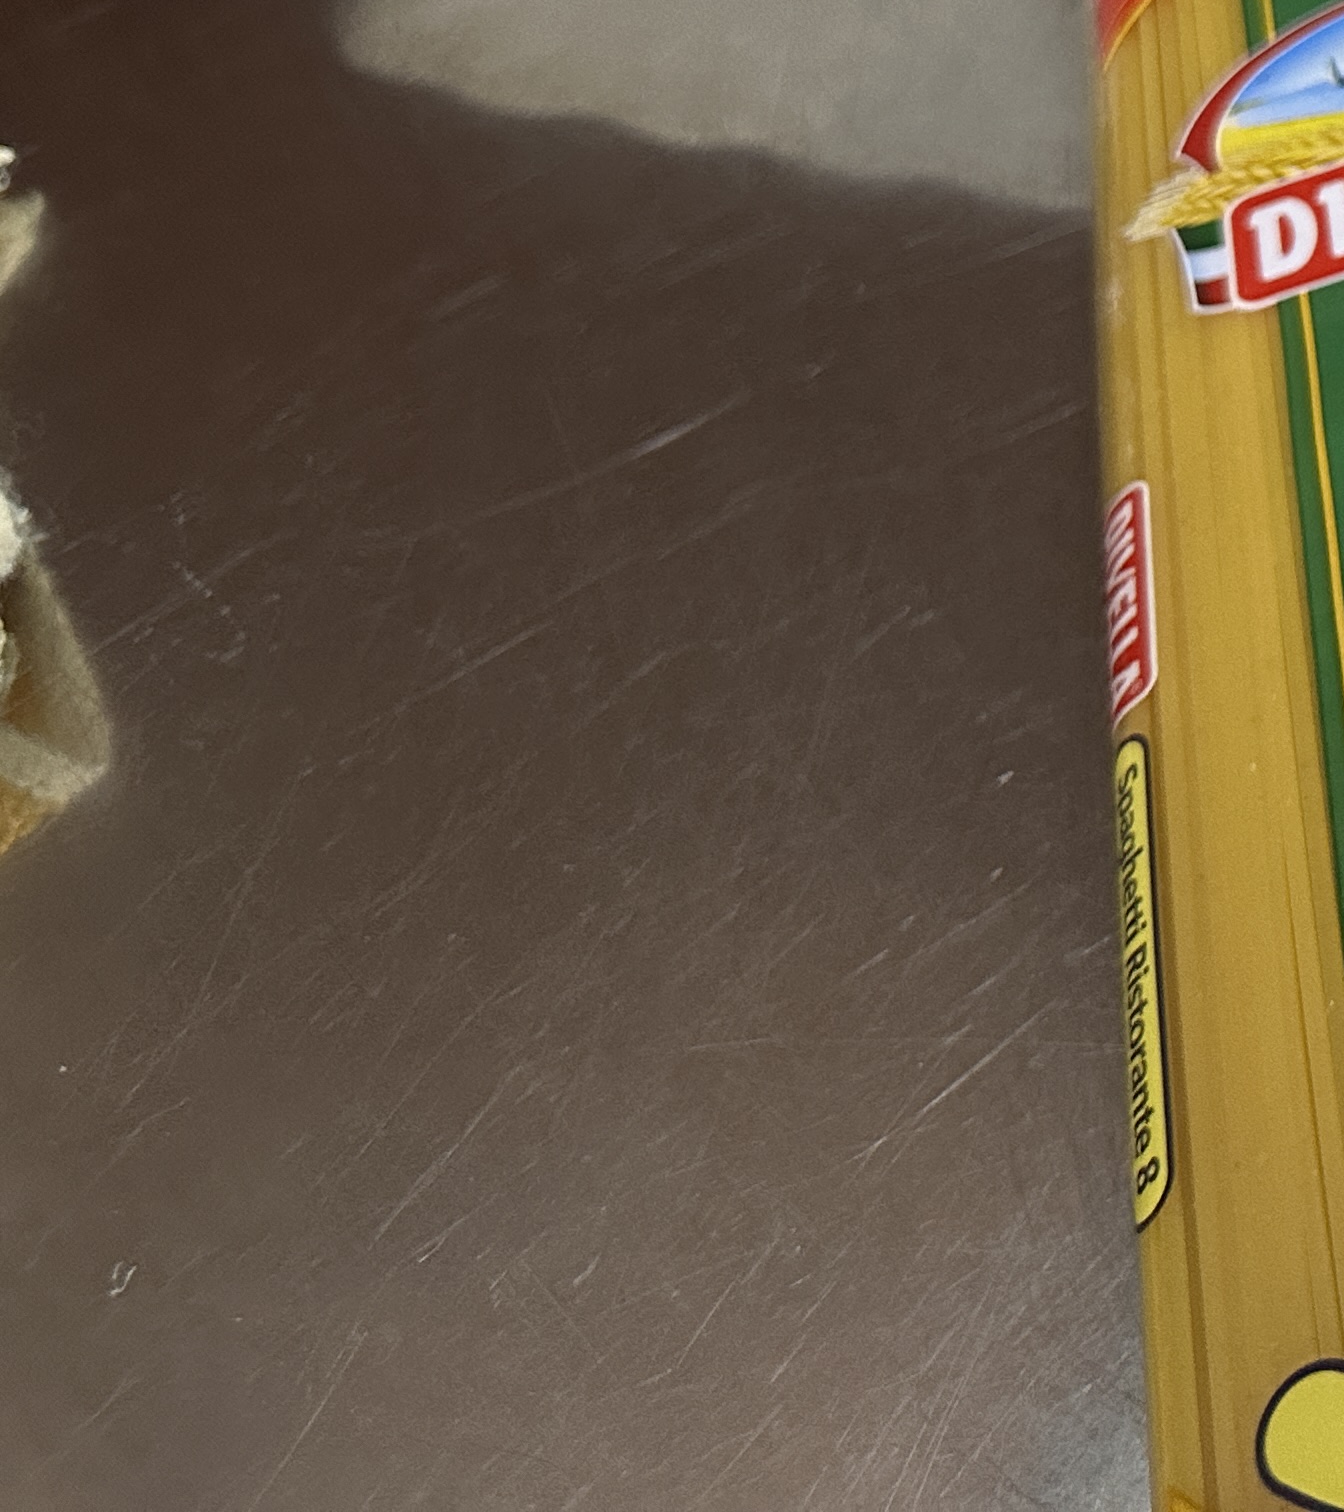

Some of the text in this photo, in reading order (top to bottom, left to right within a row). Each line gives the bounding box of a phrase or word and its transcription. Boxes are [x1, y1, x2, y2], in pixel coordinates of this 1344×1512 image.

[1117, 764, 1160, 1195] Spaghetti Ristorante 8
